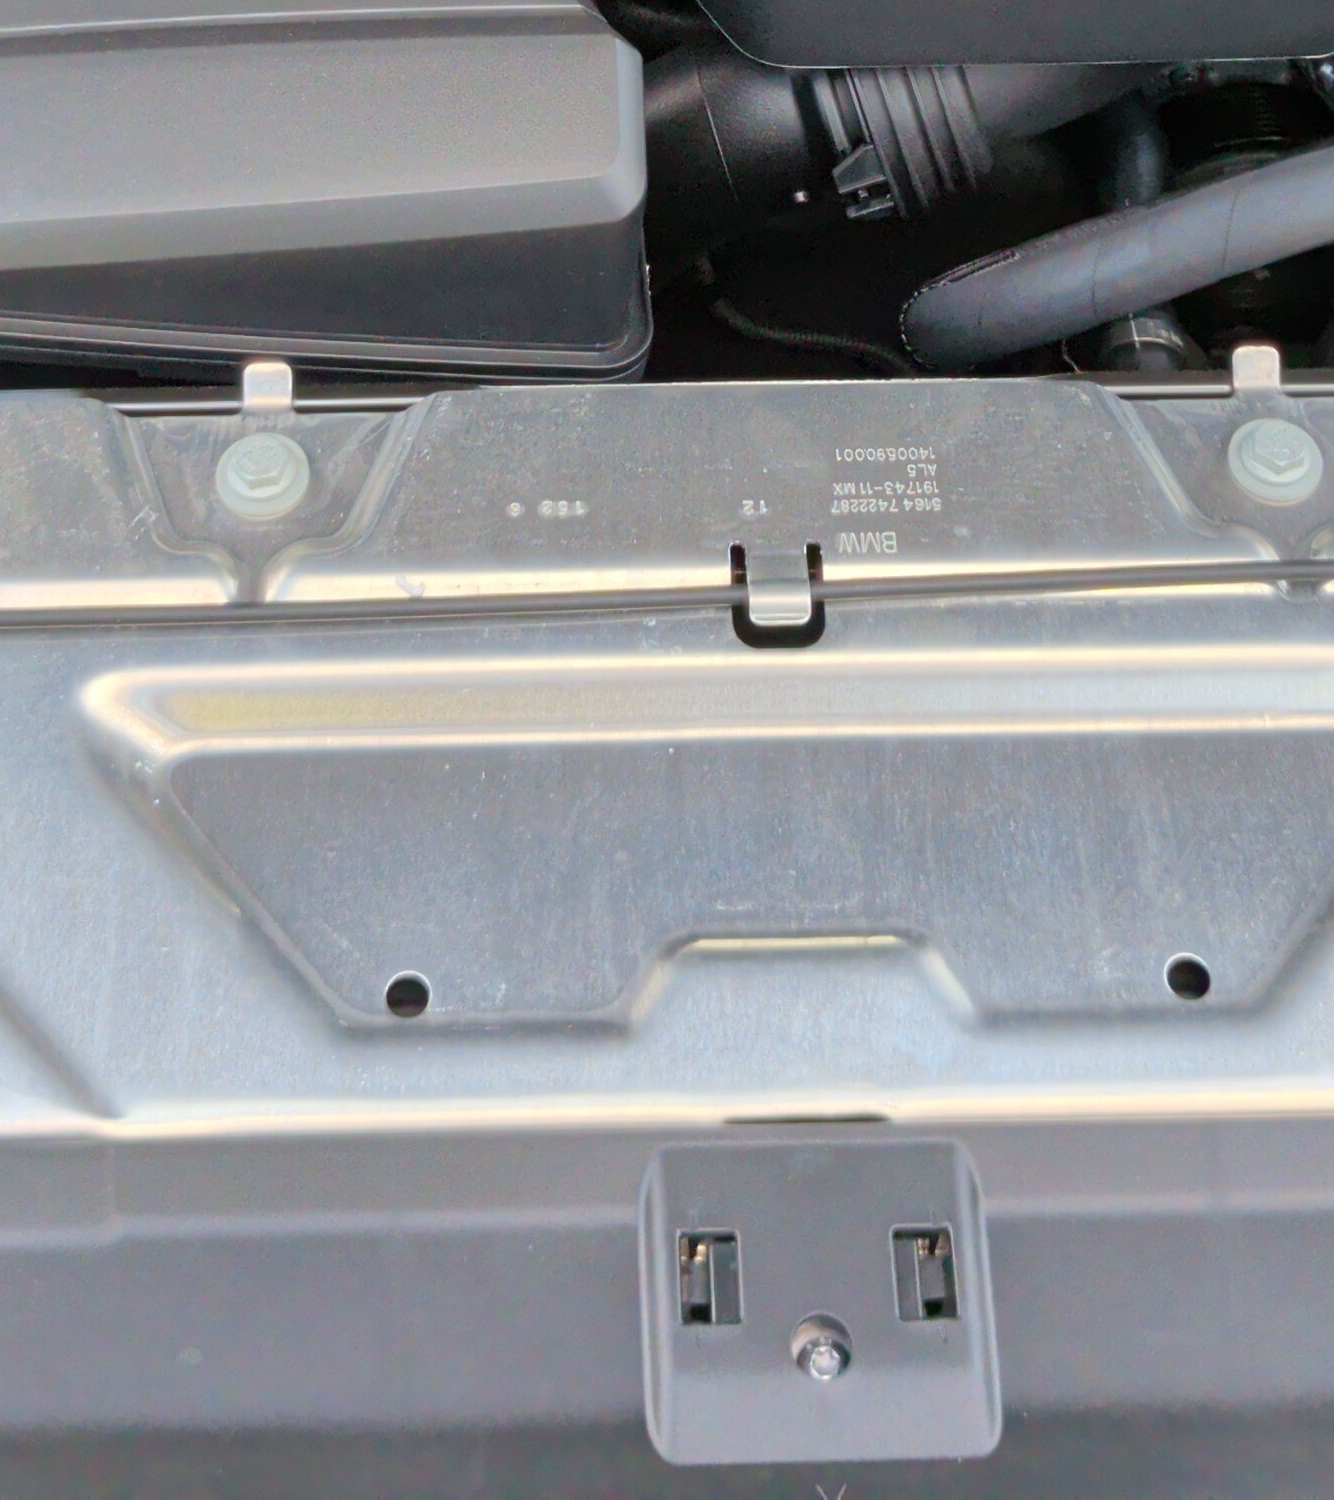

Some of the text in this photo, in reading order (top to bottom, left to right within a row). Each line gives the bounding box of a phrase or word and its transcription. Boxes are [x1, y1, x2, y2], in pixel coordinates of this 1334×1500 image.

[831, 497, 942, 513] 5164 7422287
[838, 531, 897, 554] BMW
